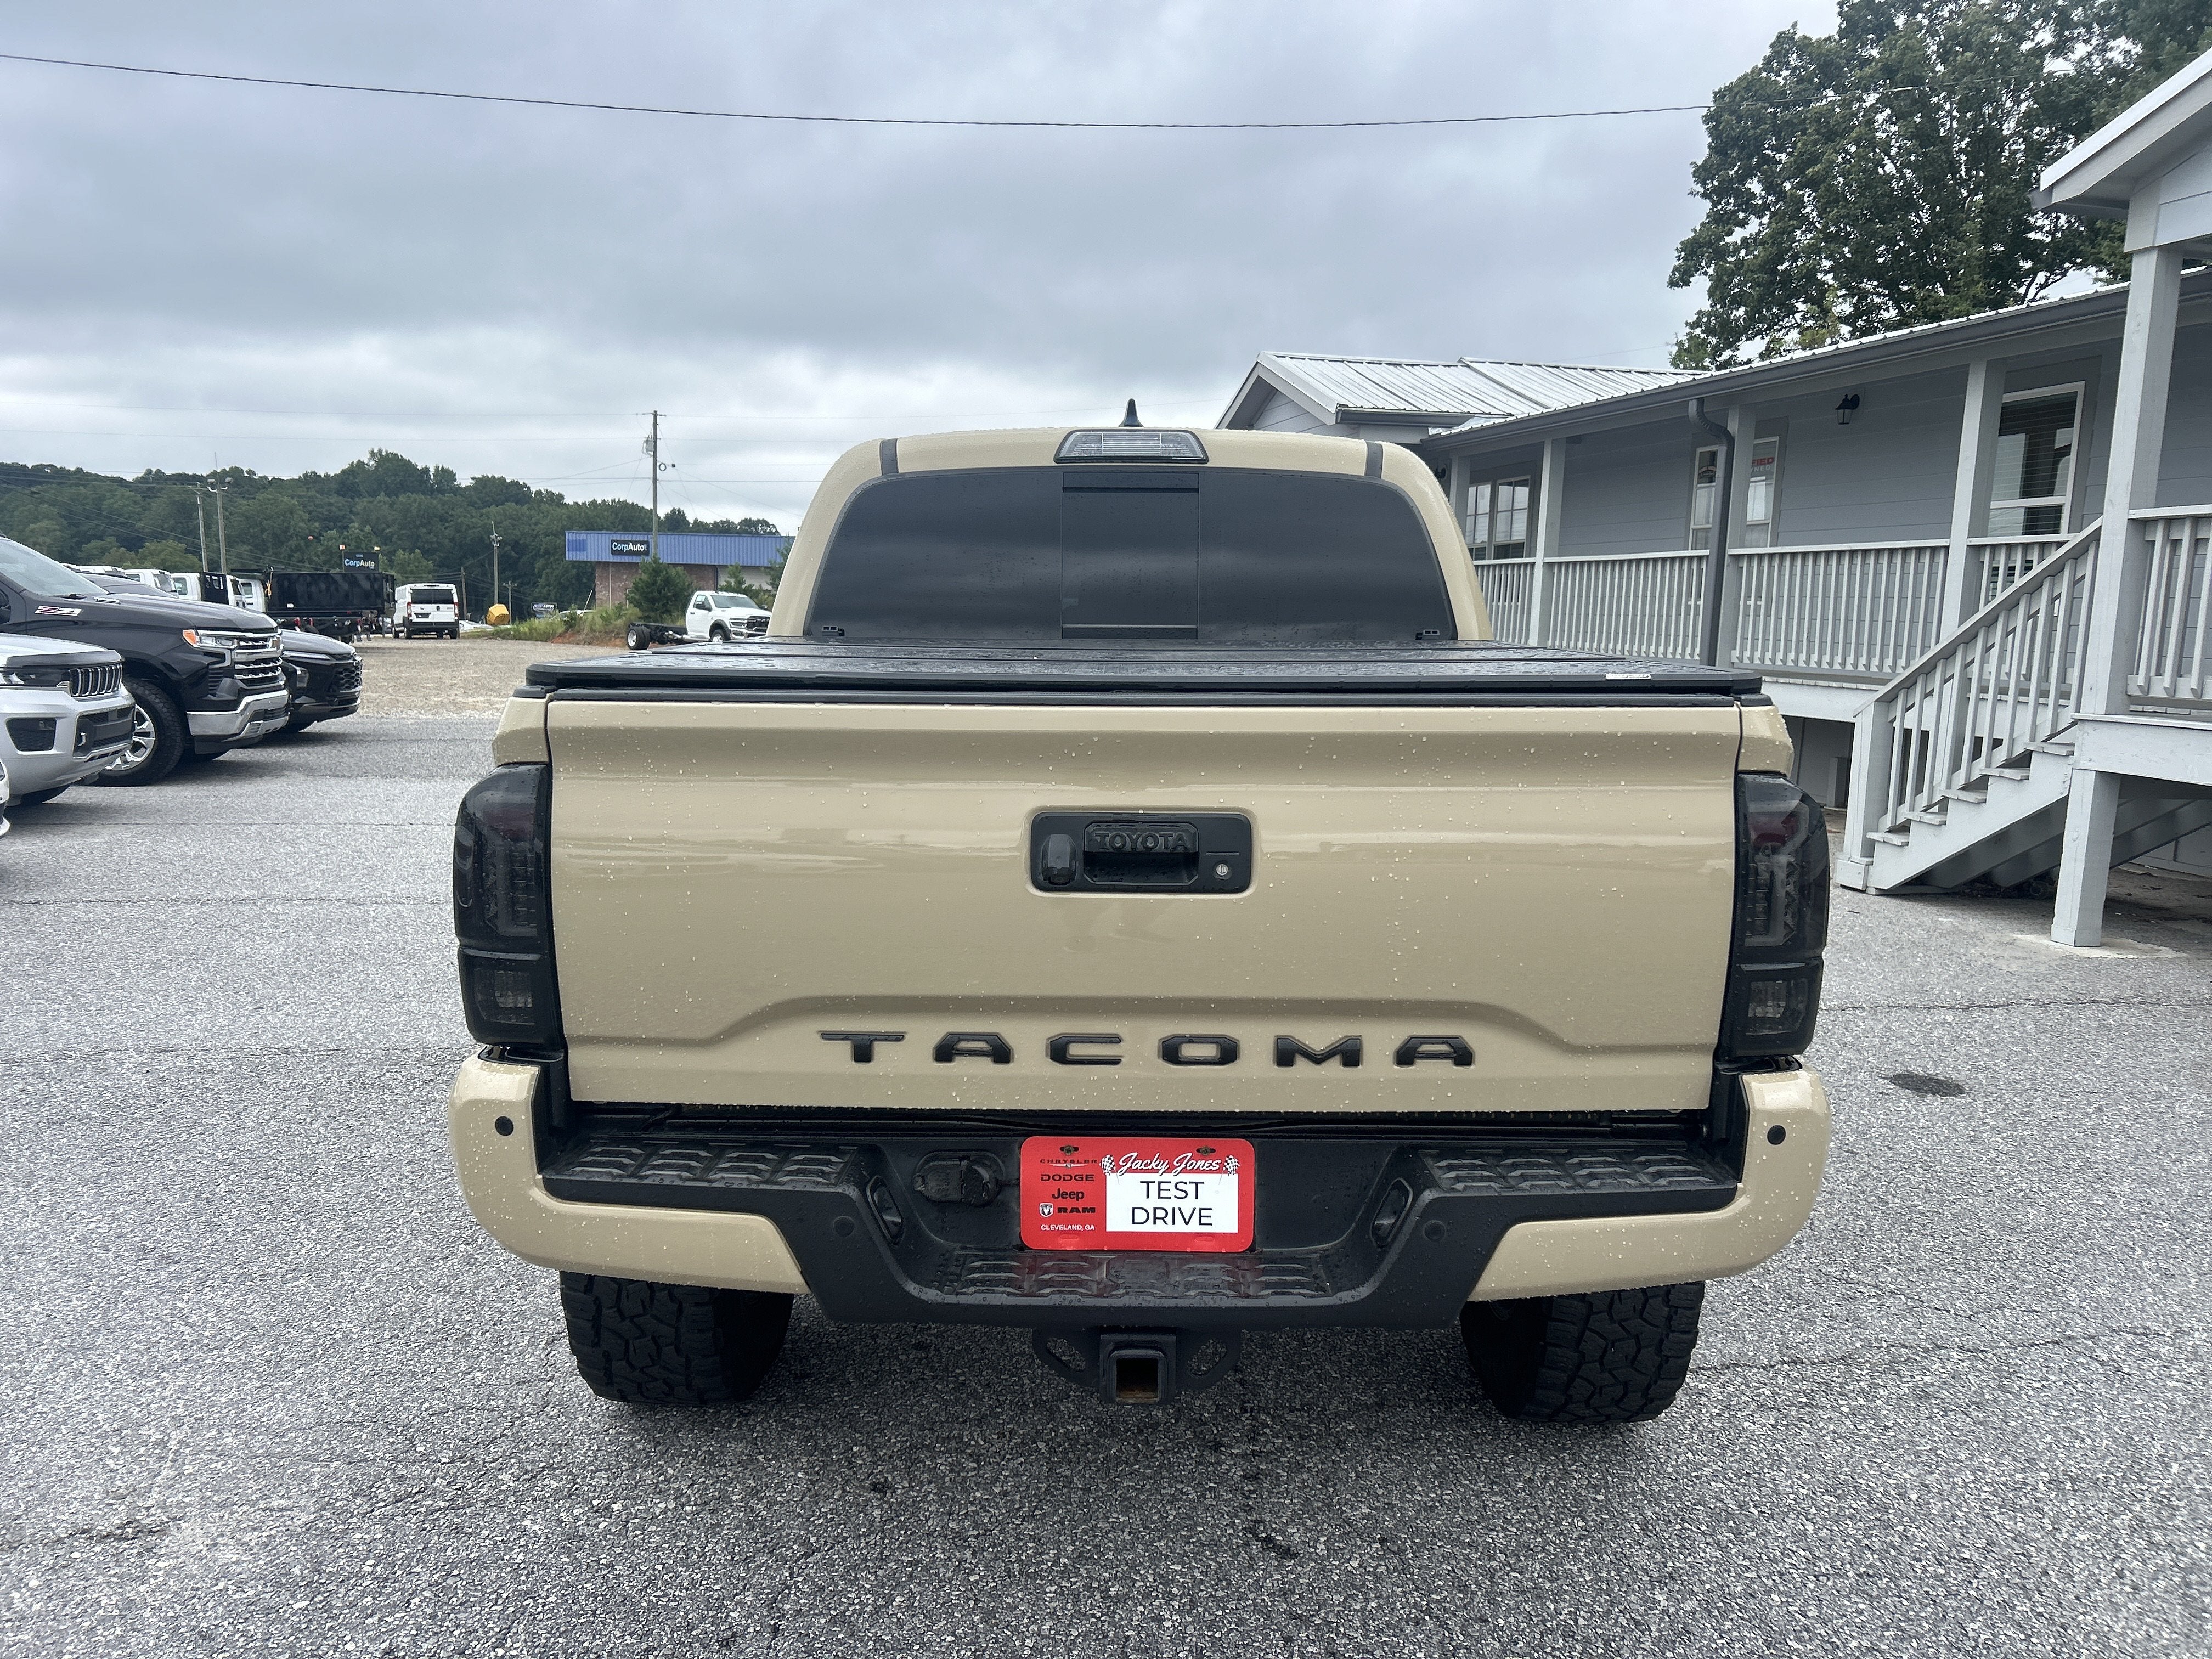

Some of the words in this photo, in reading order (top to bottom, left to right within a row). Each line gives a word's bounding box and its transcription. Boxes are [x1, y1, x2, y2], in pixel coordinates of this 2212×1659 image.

[612, 542, 645, 552] CorpAuto
[345, 558, 375, 567] CorpAuto
[1094, 832, 1190, 851] TOYOTA
[820, 1031, 1474, 1068] TACOMA
[1118, 1152, 1170, 1176] Jacky
[1171, 1153, 1222, 1176] Jones
[1052, 1188, 1085, 1201] Jeep
[1140, 1181, 1205, 1200] TEST
[1131, 1207, 1212, 1226] DRIVE
